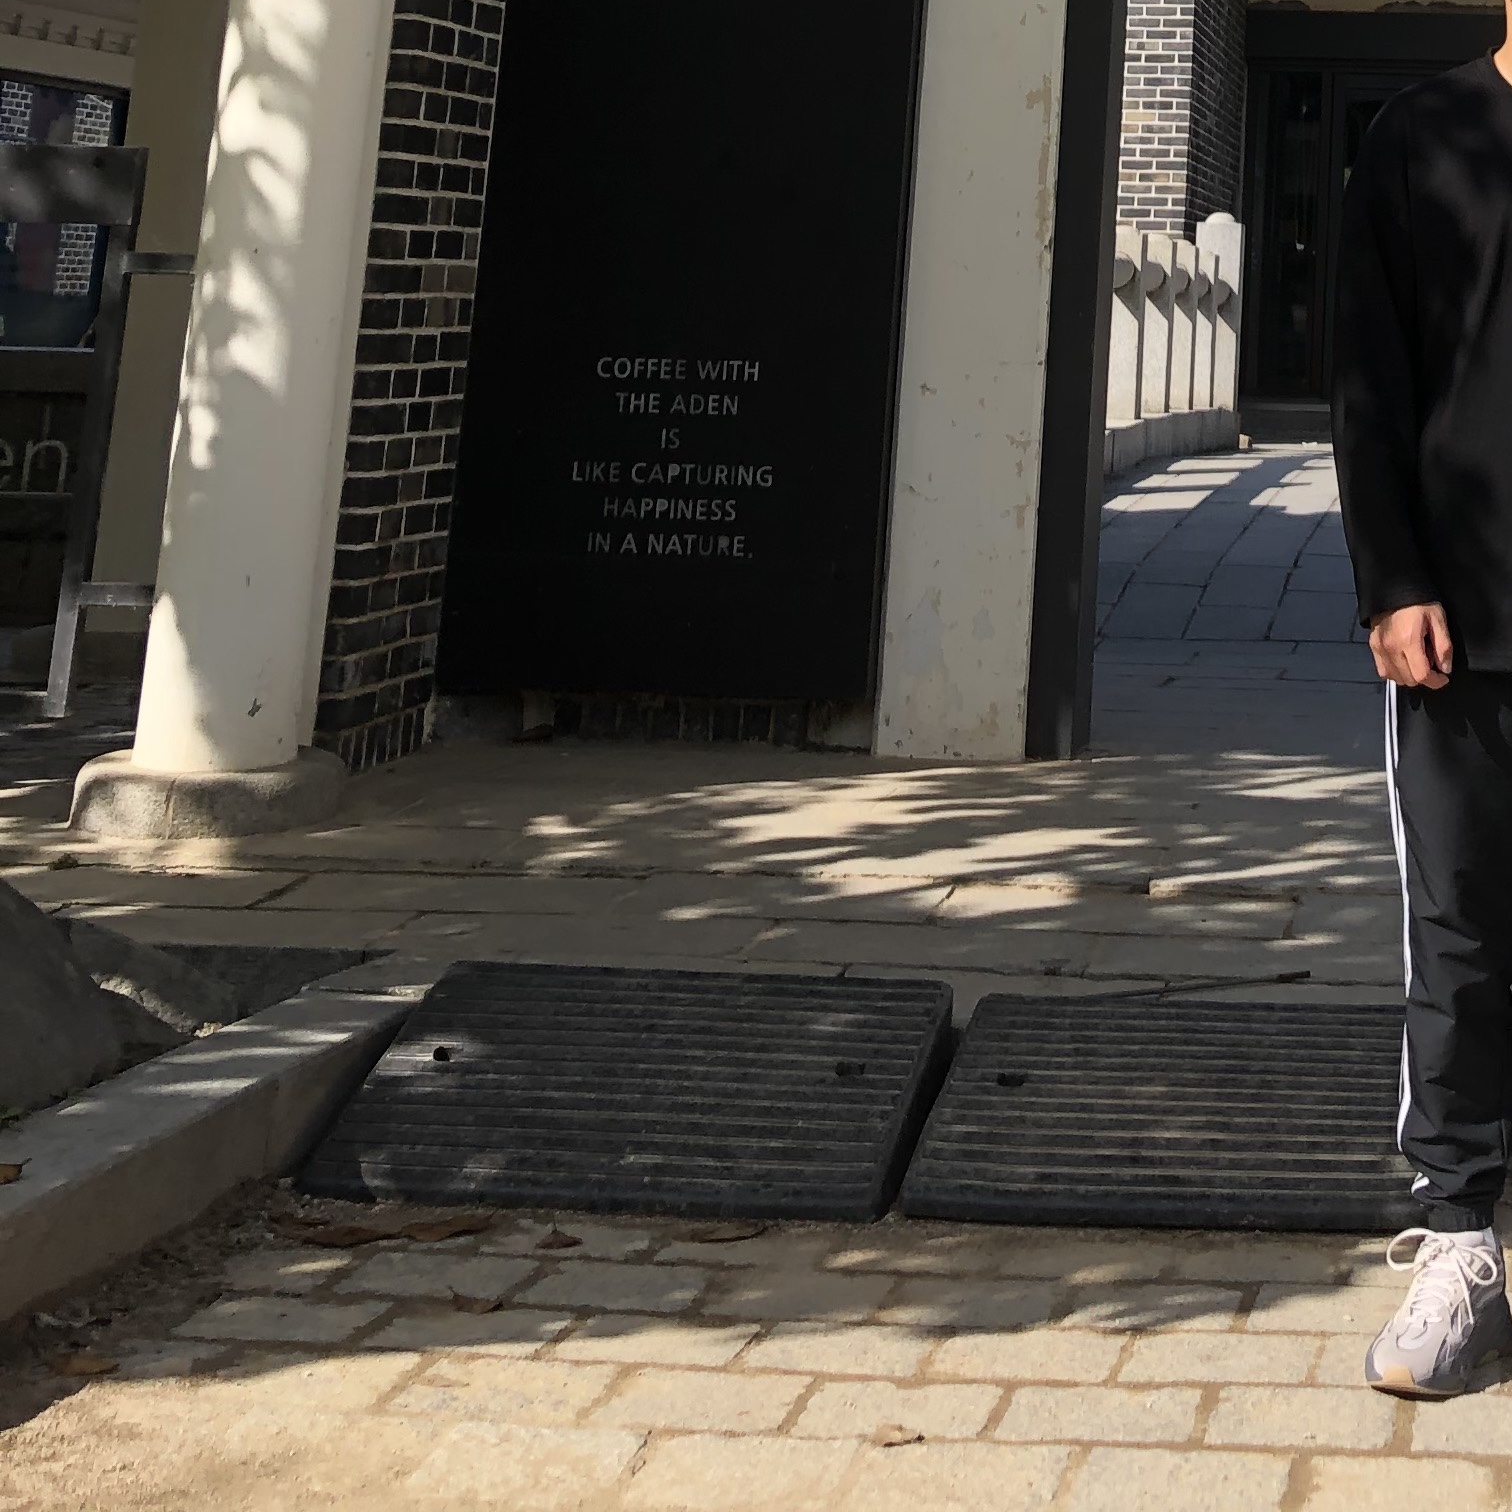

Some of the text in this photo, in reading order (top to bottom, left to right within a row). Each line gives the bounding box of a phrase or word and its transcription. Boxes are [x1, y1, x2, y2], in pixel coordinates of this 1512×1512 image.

[597, 357, 760, 381] COFFEE WITH
[616, 392, 739, 416] THE ADEN
[660, 428, 680, 449] IS
[572, 461, 774, 488] LIKE CAPTURING
[603, 497, 737, 521] HAPPINESS
[587, 532, 611, 554] IN
[619, 533, 638, 555] A
